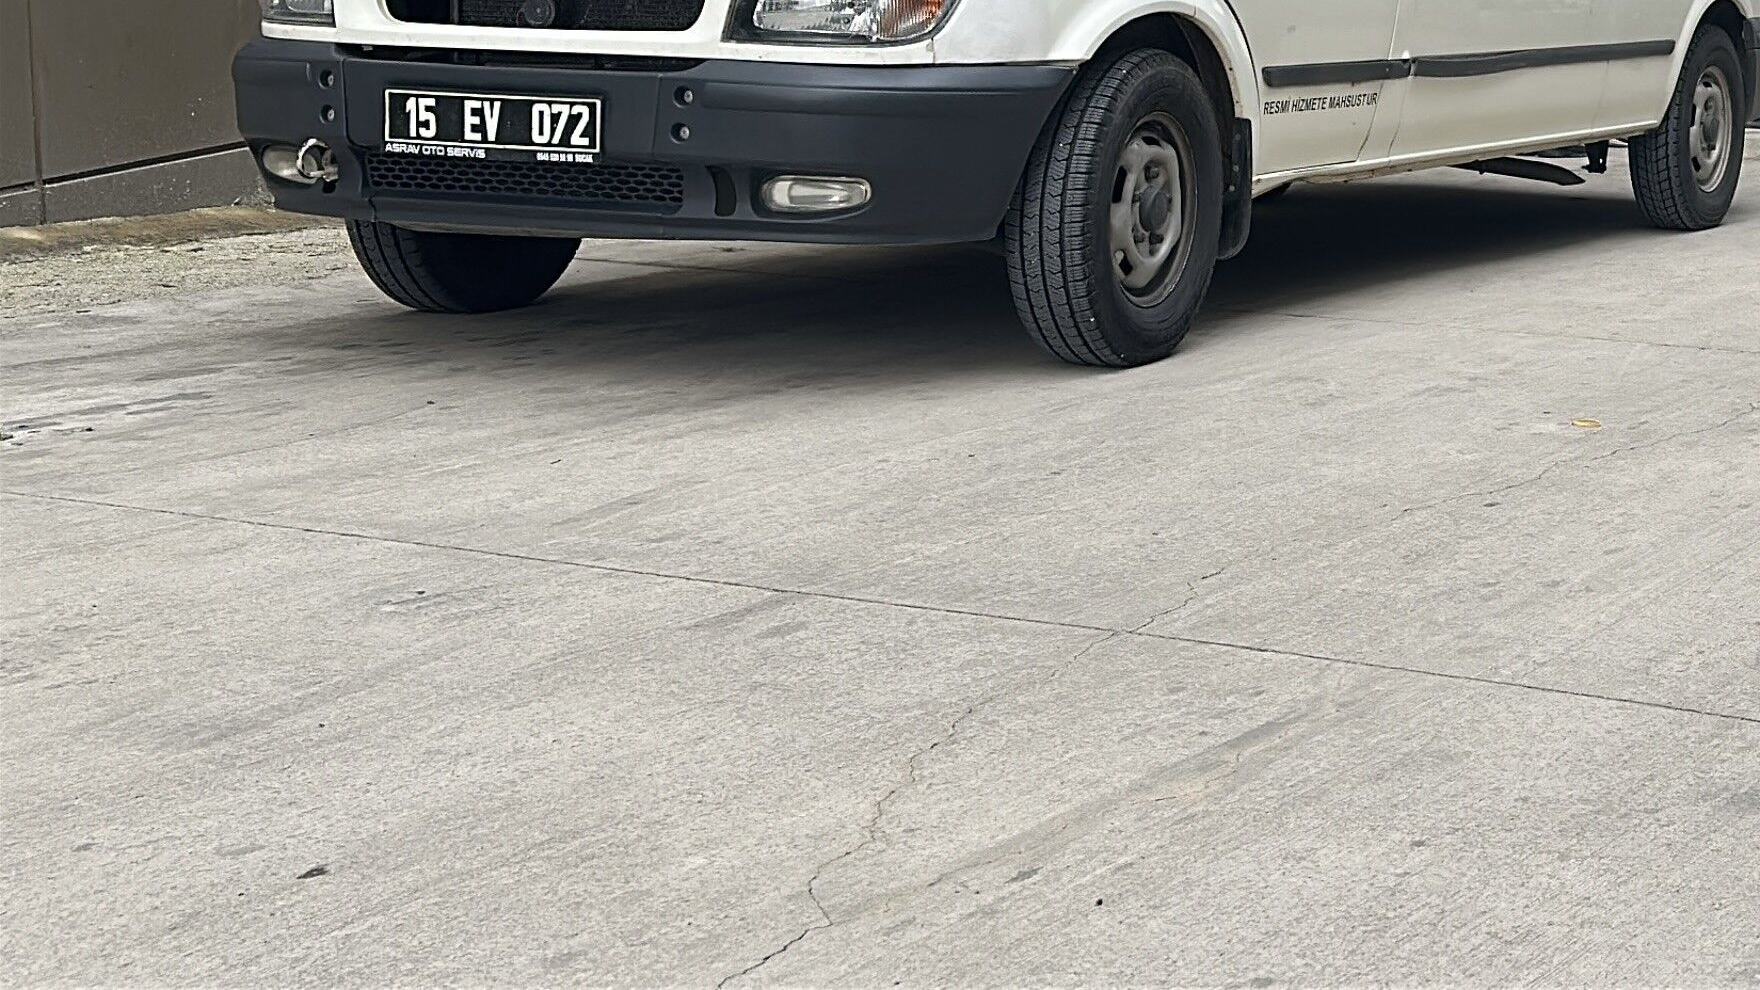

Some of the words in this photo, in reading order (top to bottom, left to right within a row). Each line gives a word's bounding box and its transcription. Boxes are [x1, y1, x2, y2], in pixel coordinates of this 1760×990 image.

[405, 97, 437, 138] 15
[463, 100, 501, 142] EV
[531, 103, 590, 146] 072
[385, 143, 420, 155] ASRAV
[421, 145, 445, 156] OTO
